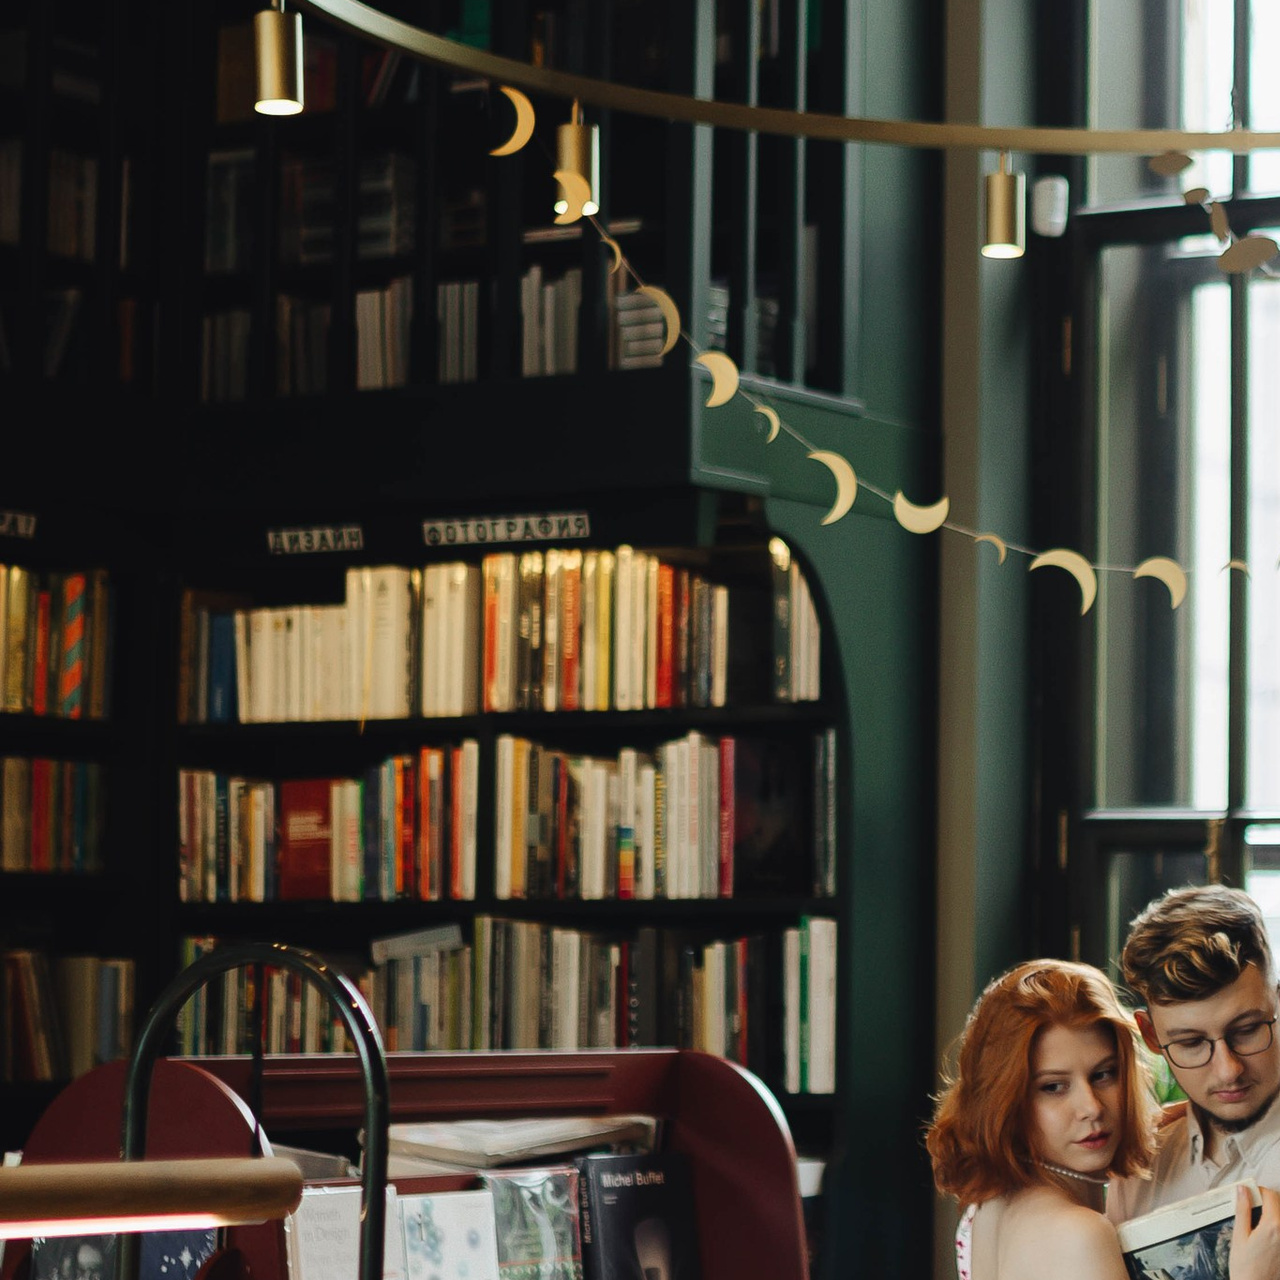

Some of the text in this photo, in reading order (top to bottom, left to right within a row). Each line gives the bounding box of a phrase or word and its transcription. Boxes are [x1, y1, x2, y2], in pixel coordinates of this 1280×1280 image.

[425, 515, 588, 545] ФОТОГРАФИЯ
[601, 1169, 666, 1188] Michel Buffet
[581, 1210, 593, 1244] Michel
